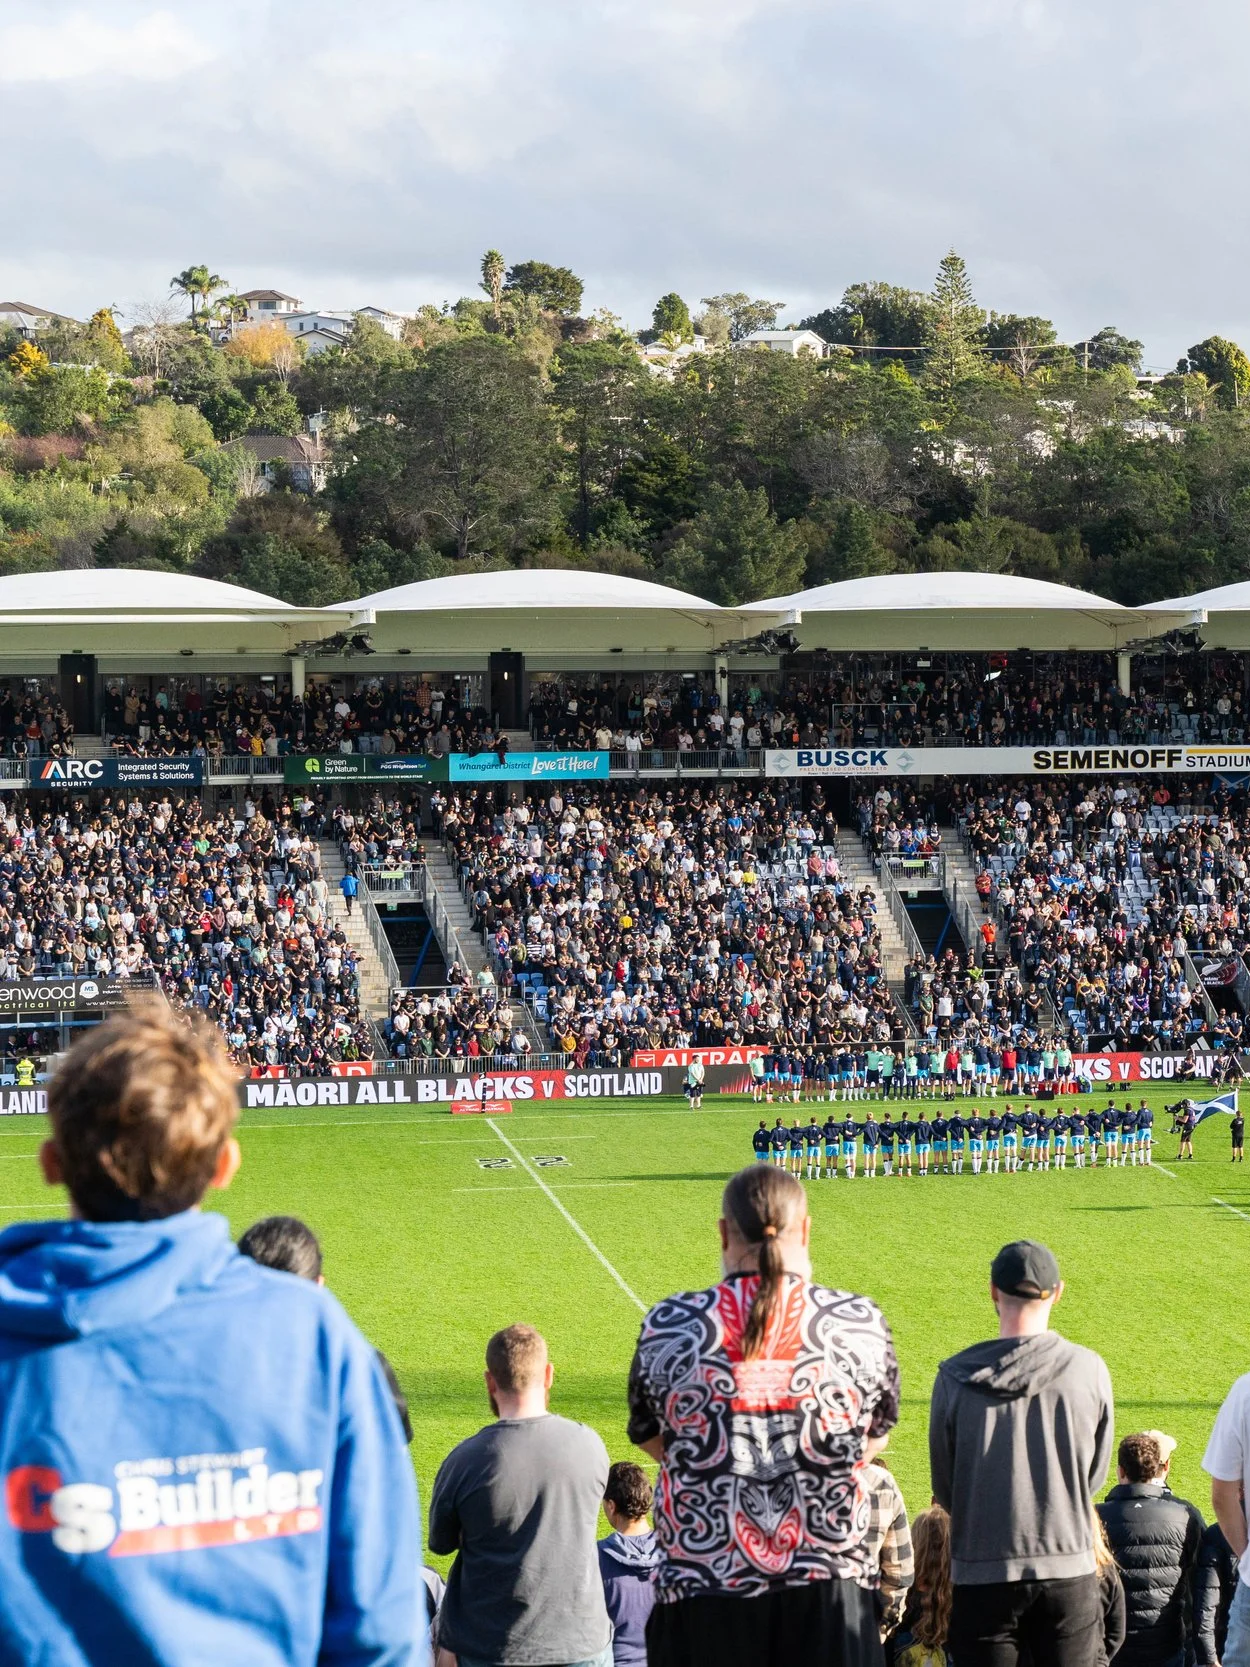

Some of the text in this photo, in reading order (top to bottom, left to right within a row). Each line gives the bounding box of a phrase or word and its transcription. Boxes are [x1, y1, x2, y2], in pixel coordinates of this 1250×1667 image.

[118, 762, 190, 772] Integrated Security
[532, 756, 555, 775] Love
[566, 756, 599, 772] Here!
[797, 751, 888, 766] BUSCK
[1033, 749, 1182, 769] SEMENOFF
[40, 760, 104, 779] ARC
[118, 772, 150, 782] Systems
[160, 772, 194, 780] Solutions
[325, 766, 336, 774] by
[246, 1079, 348, 1107] MĀORI
[356, 1080, 411, 1104] ALL
[416, 1076, 534, 1102] BLACKS
[564, 1072, 663, 1097] SCOTLAND
[115, 1464, 324, 1532] Builder
